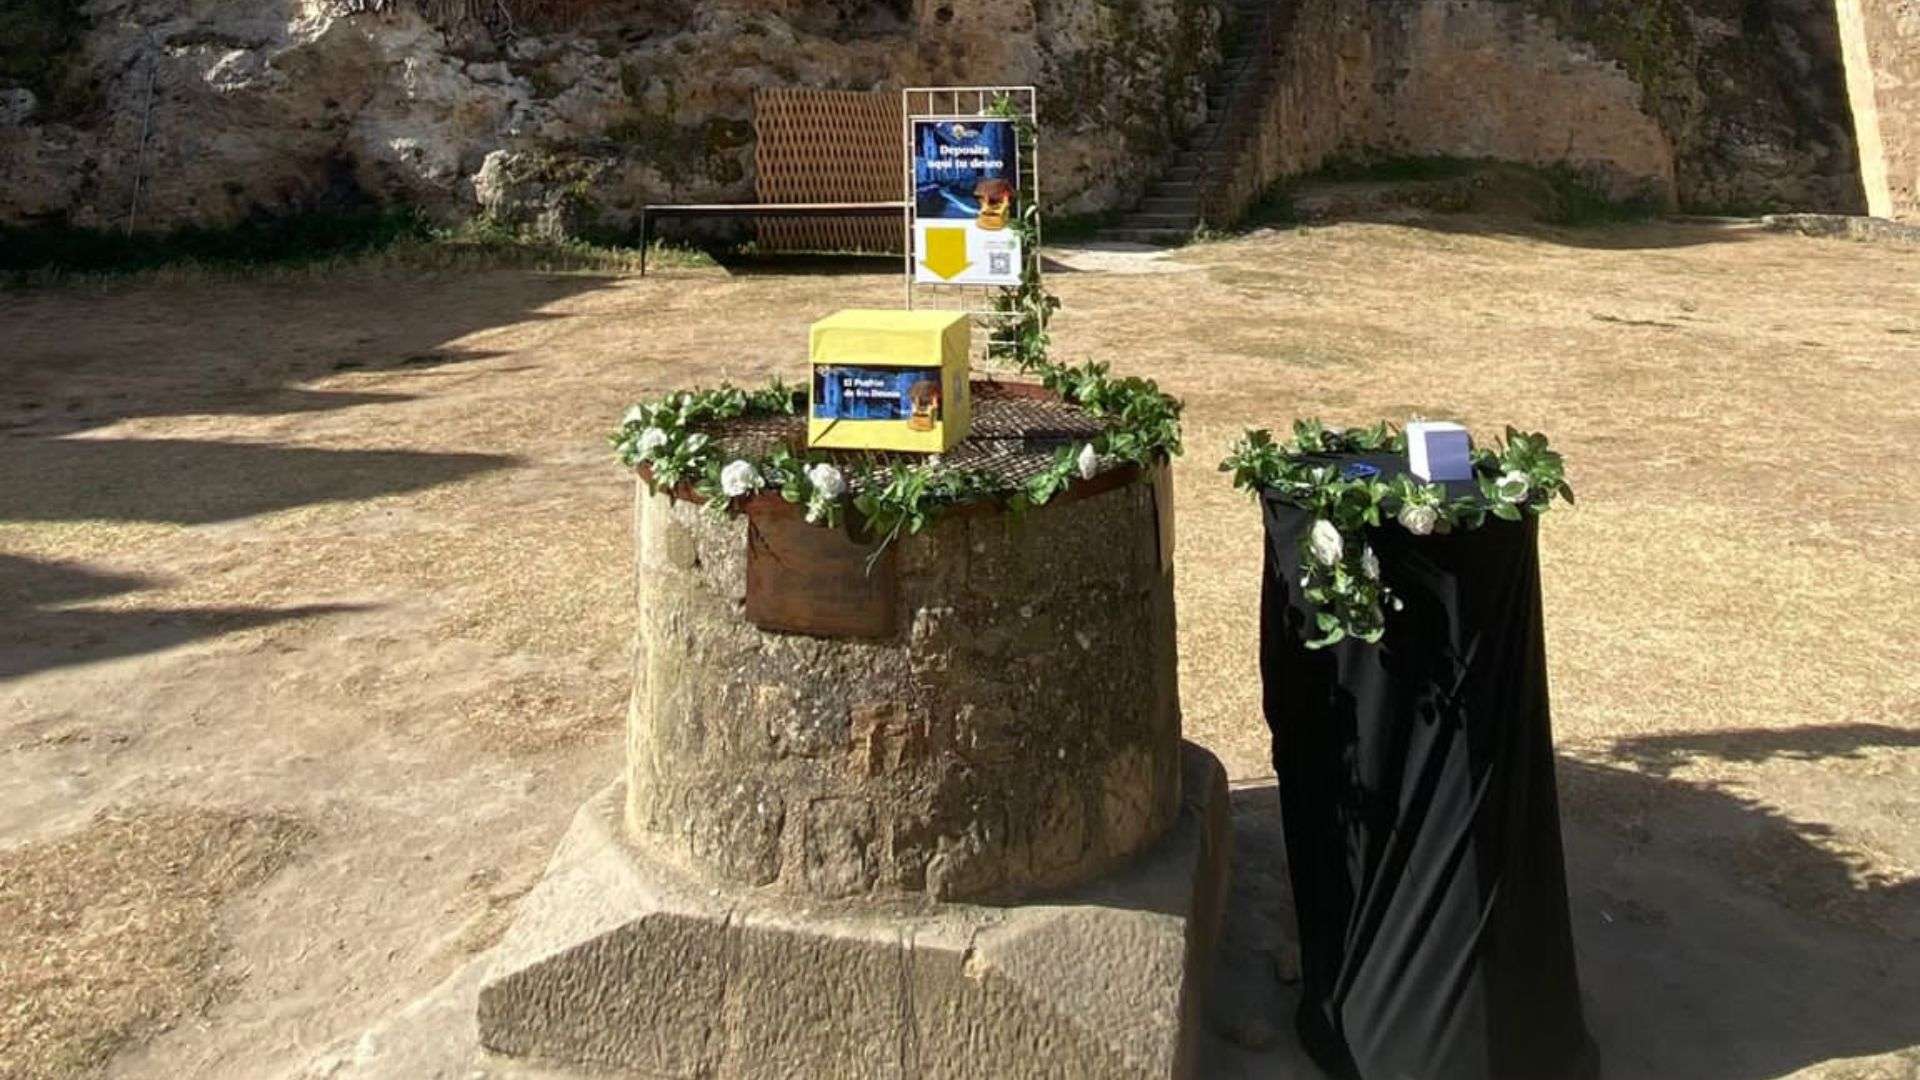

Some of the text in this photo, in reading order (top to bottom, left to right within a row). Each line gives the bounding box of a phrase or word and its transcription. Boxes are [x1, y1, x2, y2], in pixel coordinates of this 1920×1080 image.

[940, 144, 989, 156] Deposita
[955, 159, 967, 168] tu
[970, 158, 1004, 168] deseo
